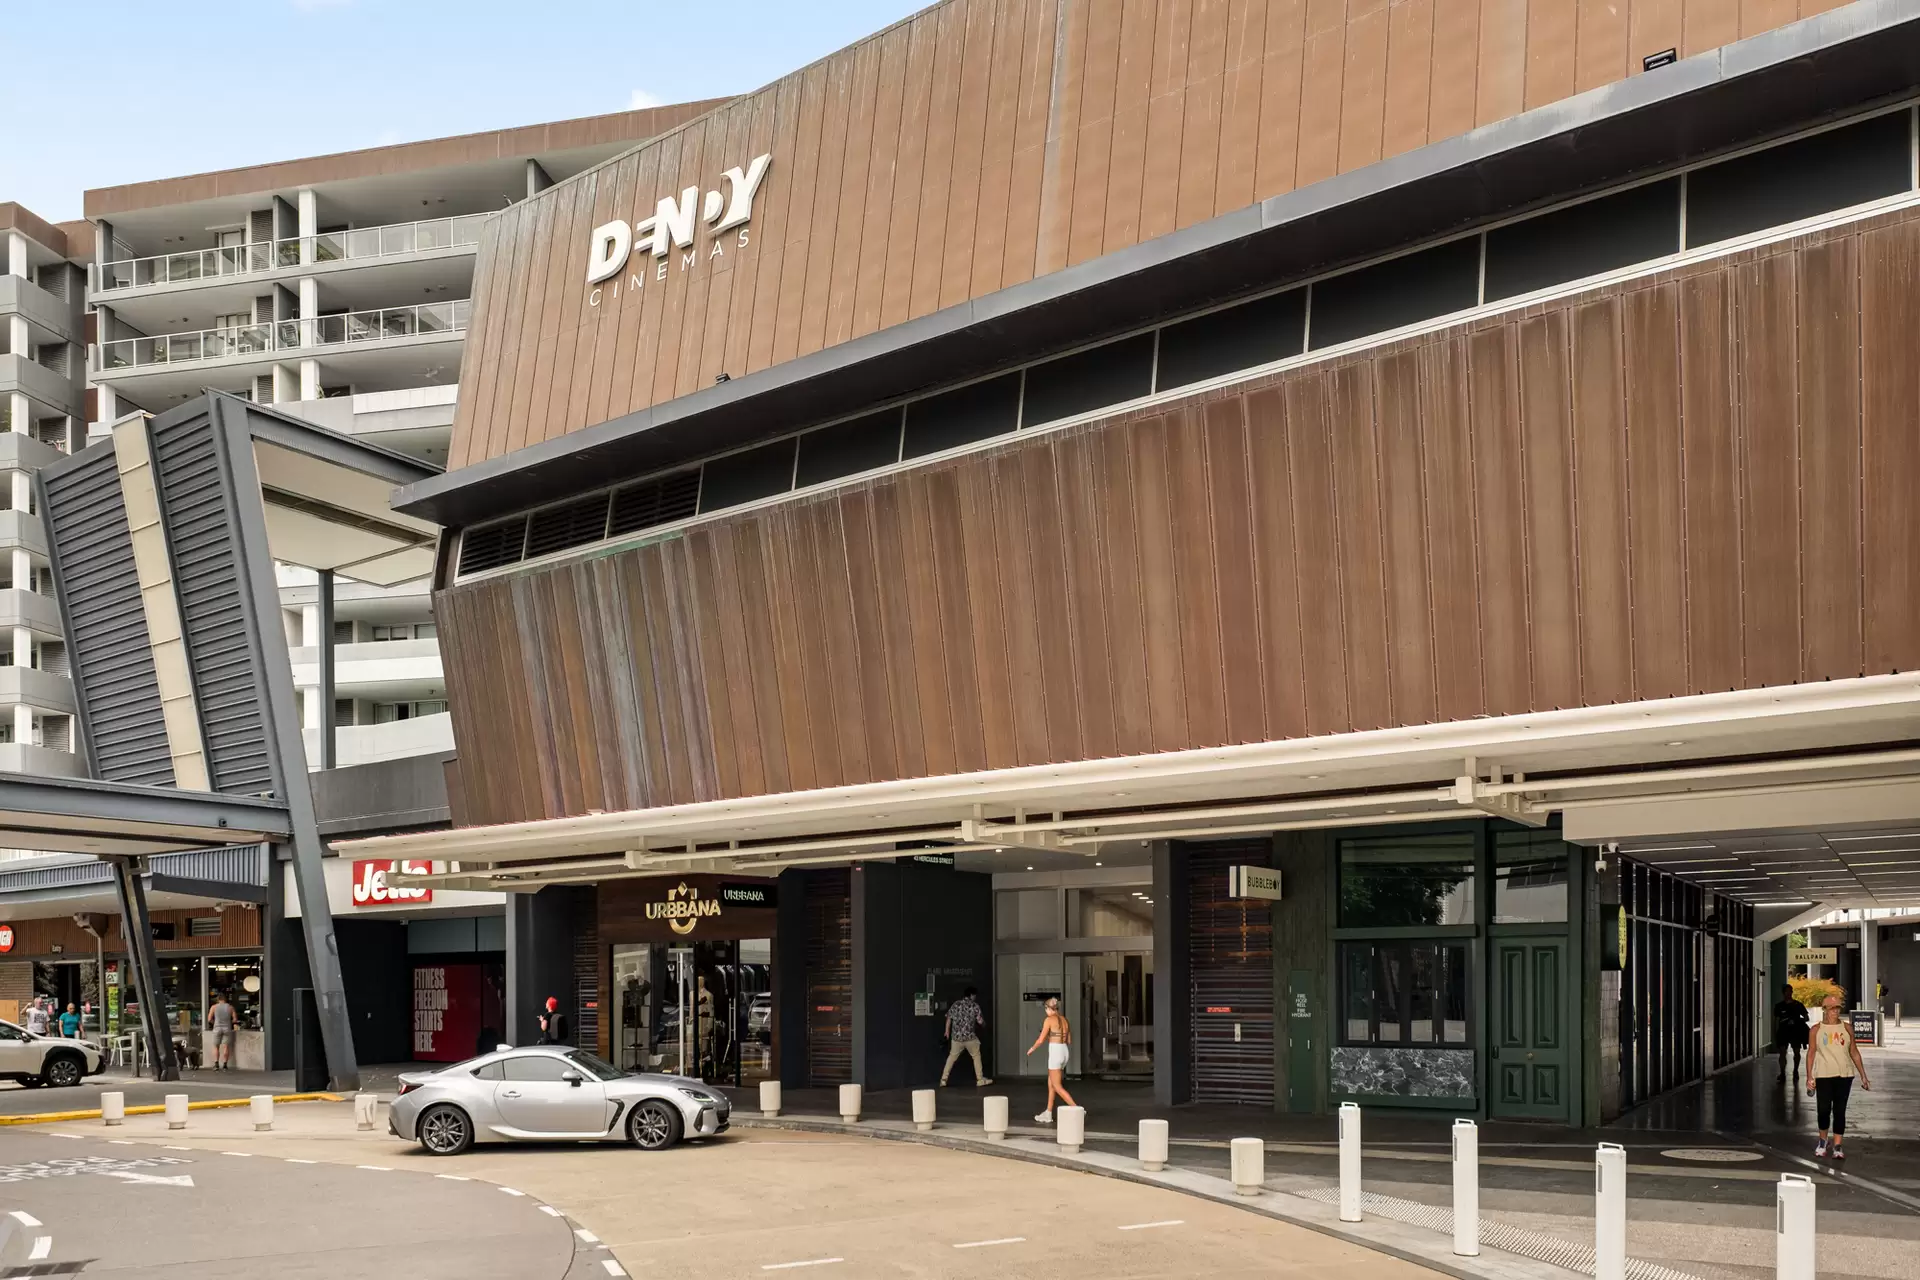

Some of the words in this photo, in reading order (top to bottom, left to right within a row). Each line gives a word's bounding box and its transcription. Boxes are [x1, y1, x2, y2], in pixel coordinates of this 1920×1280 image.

[589, 229, 750, 307] CINEMAS
[1248, 876, 1280, 890] BUBBLEBOY
[724, 889, 765, 902] URBBANA
[645, 899, 721, 920] URBBANA
[414, 968, 445, 989] FITNESS
[414, 989, 448, 1010] FREEDOM
[414, 1010, 443, 1031] STARTS
[414, 1031, 436, 1052] HERE.
